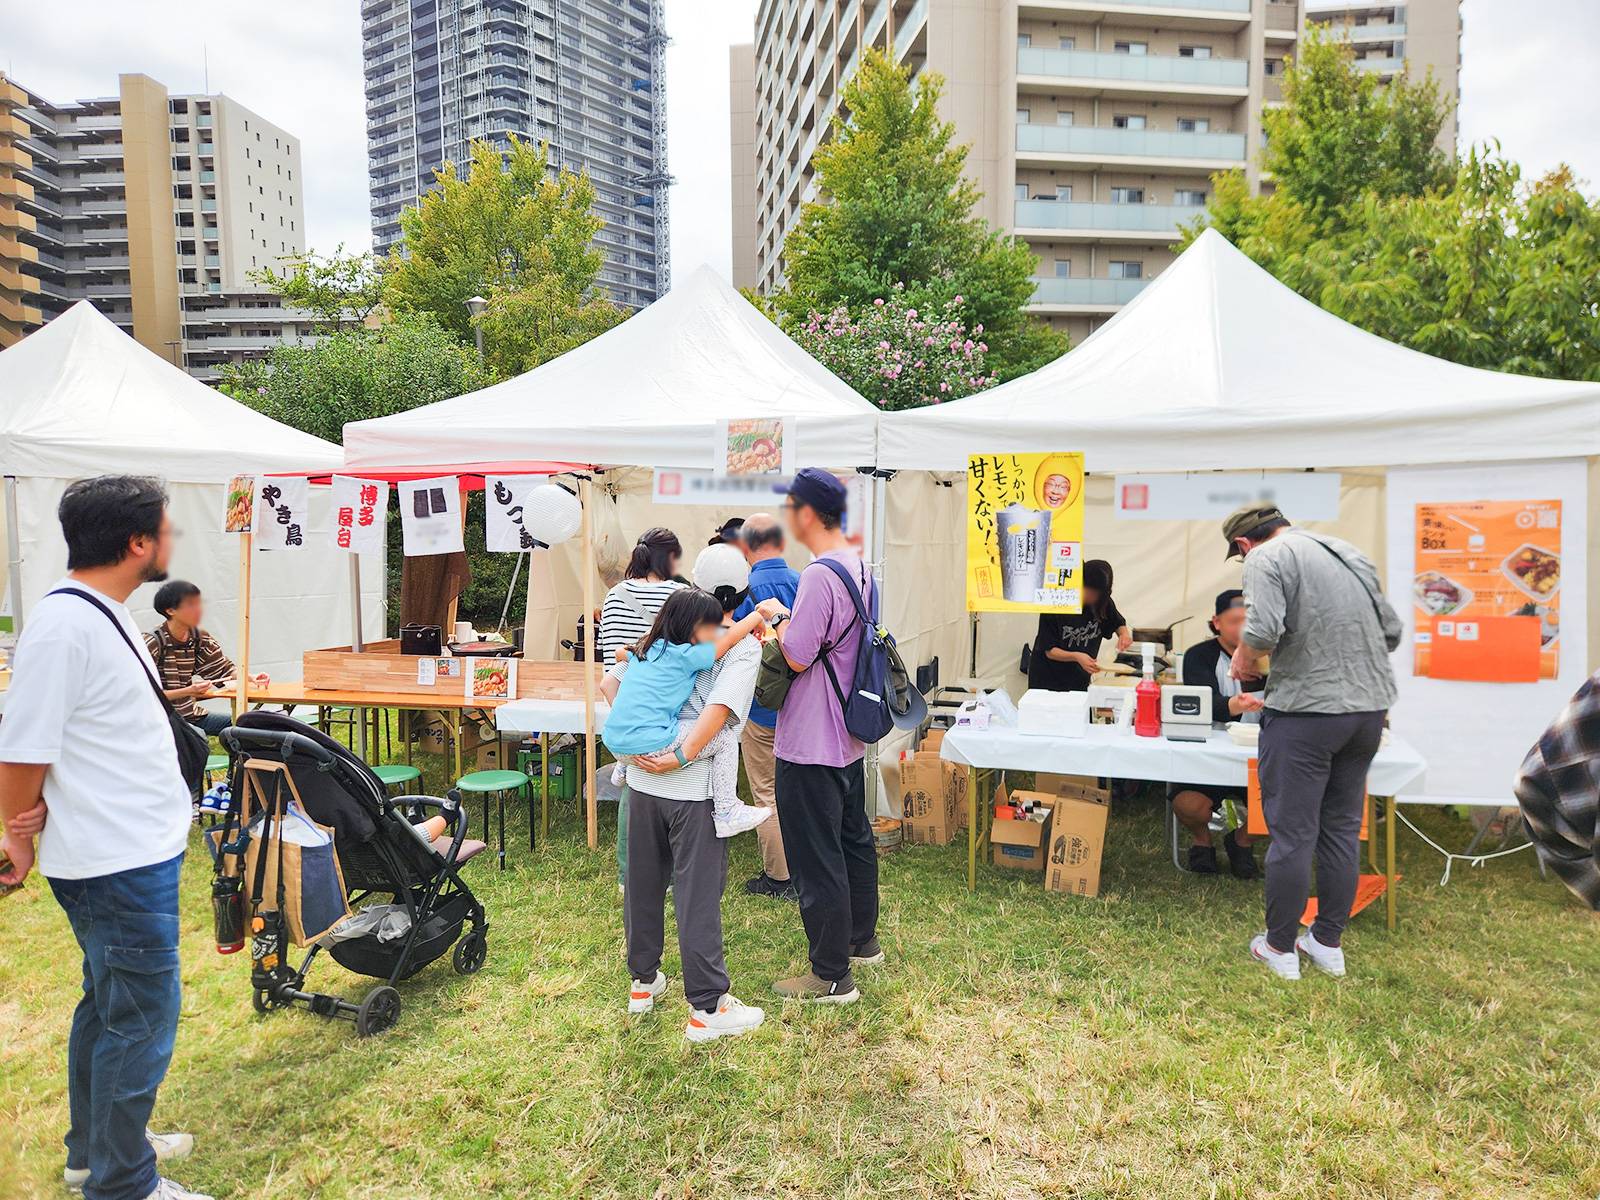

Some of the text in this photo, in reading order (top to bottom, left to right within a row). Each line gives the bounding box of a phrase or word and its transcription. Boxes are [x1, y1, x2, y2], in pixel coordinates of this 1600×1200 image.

[1011, 455, 1026, 503] しっかり
[261, 484, 303, 546] やき鳥
[337, 507, 354, 548] 屋台
[358, 484, 379, 527] 博多
